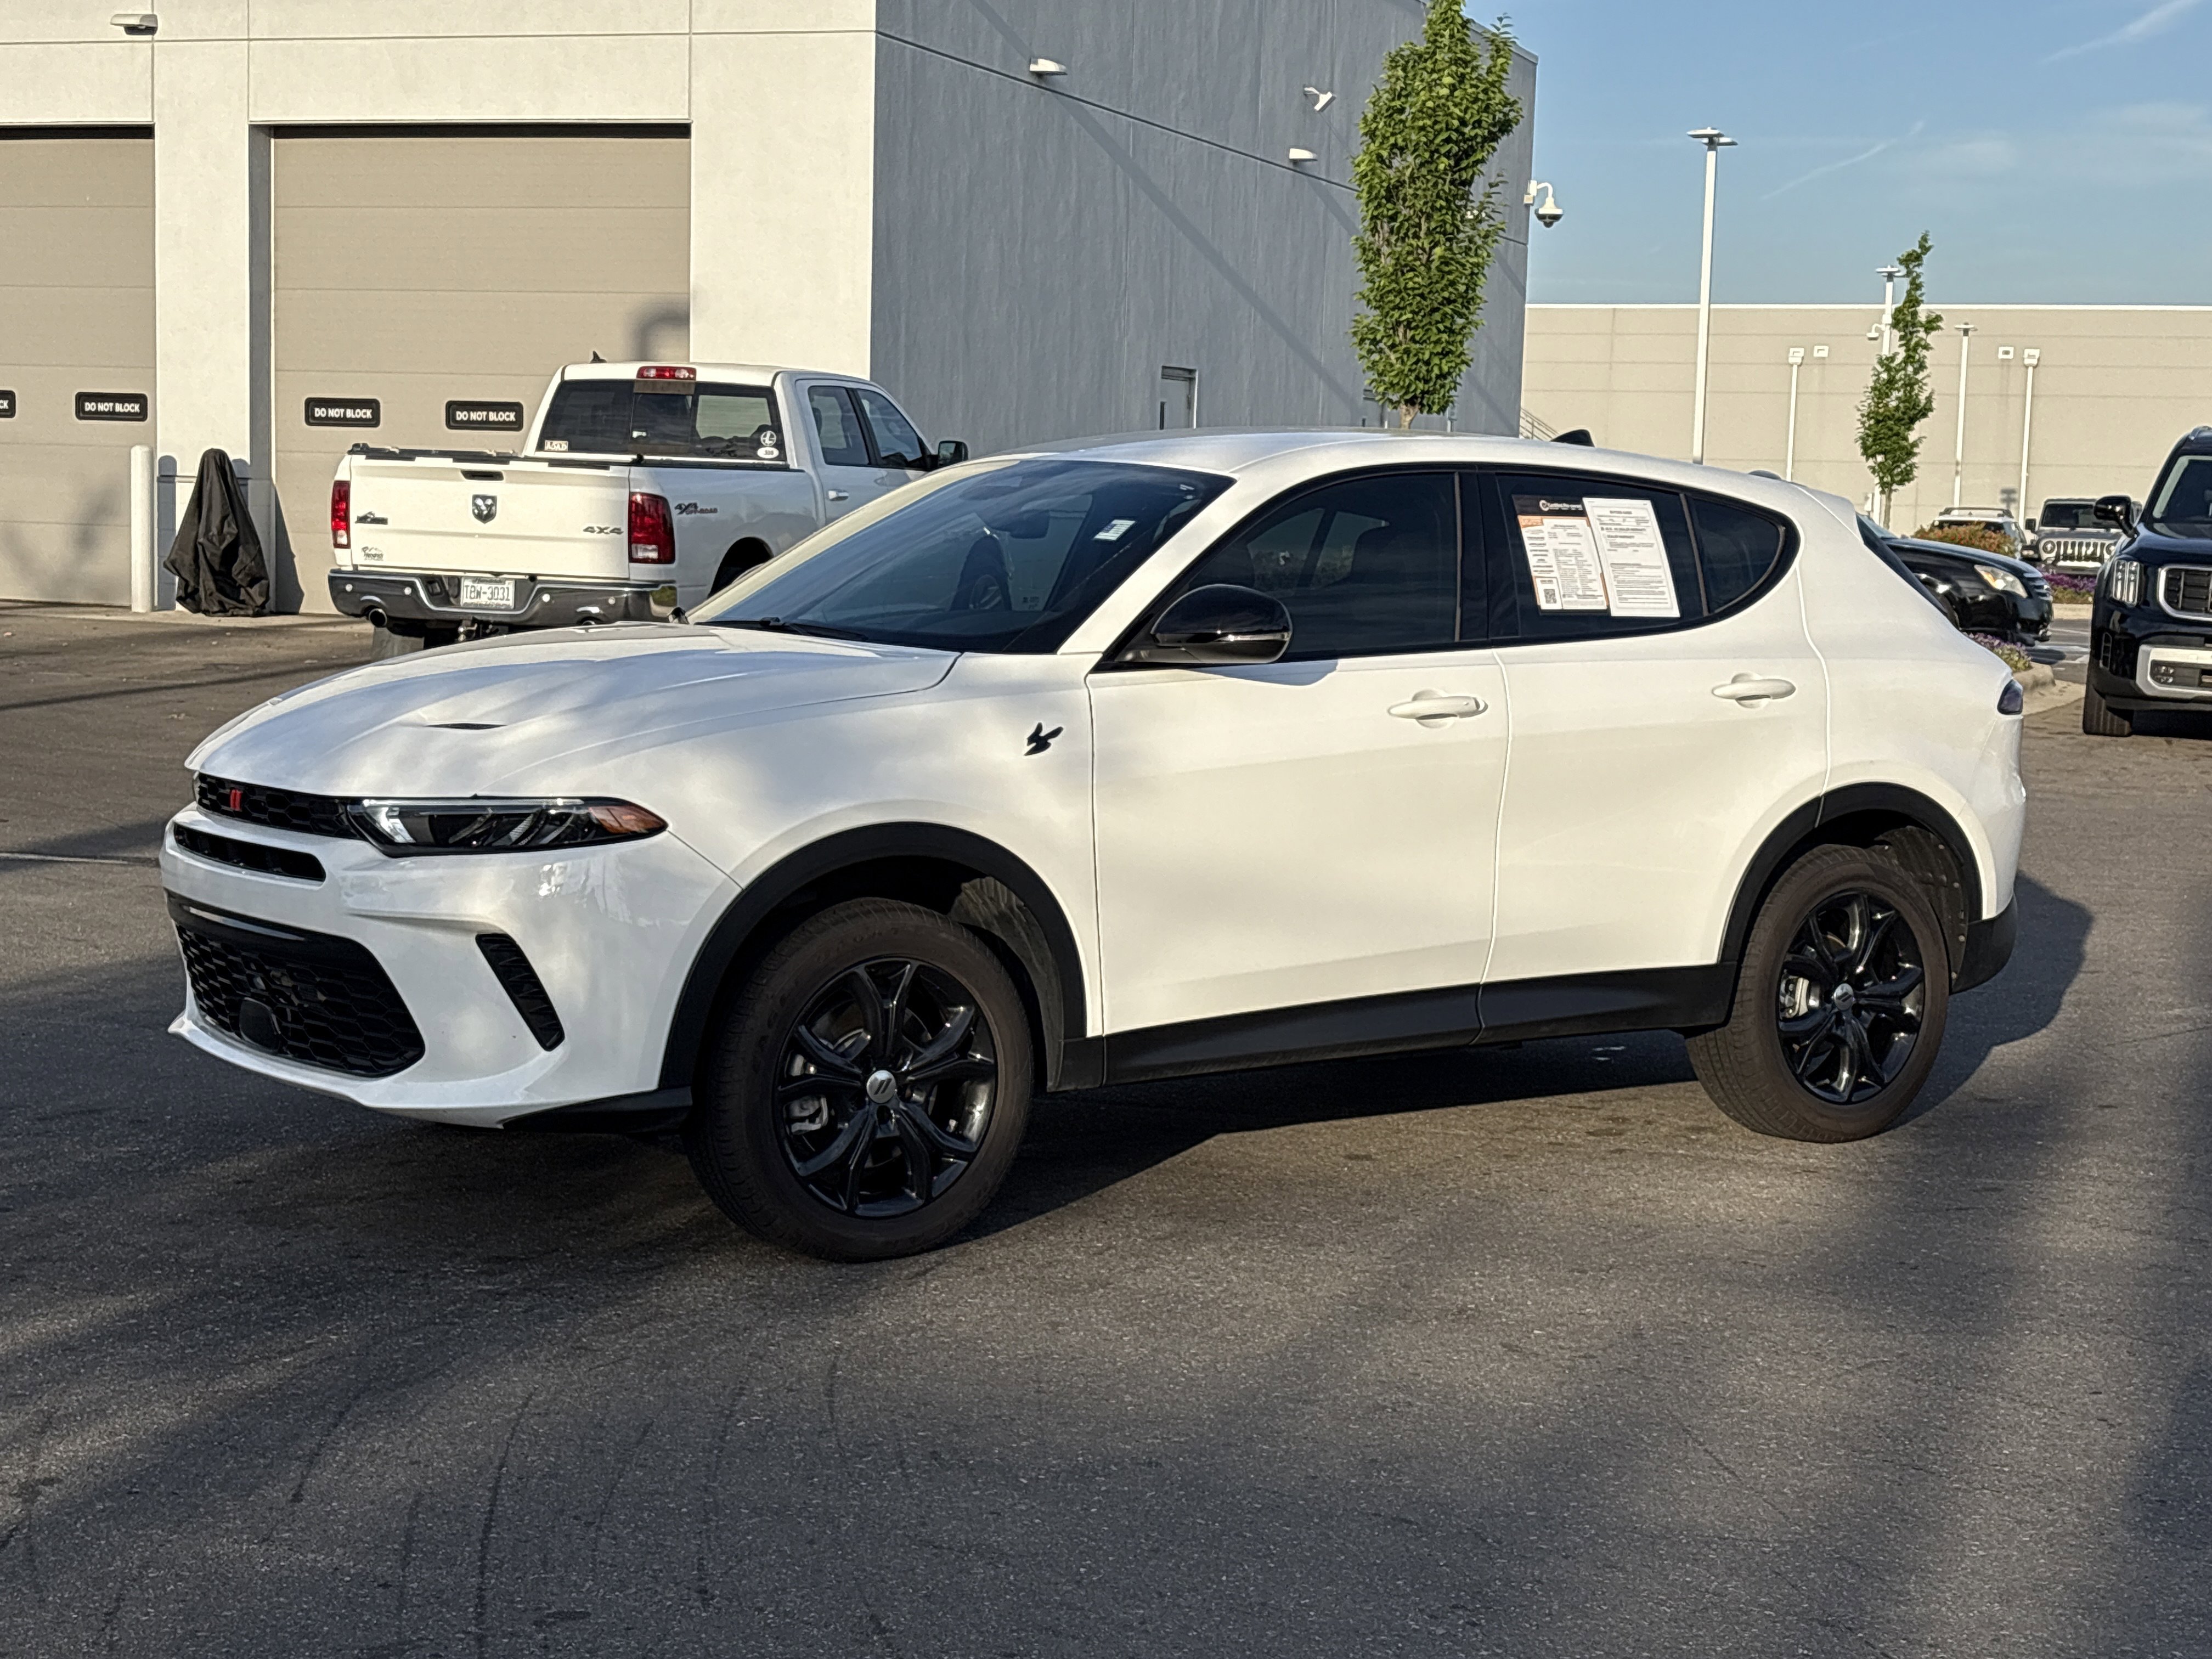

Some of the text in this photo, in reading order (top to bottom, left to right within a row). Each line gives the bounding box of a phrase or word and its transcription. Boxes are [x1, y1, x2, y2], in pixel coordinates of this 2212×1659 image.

[84, 402, 140, 413] DO NOT BLOCK
[314, 408, 373, 419] DO NOT BLOCK
[456, 411, 516, 421] DO NOT BLOCK
